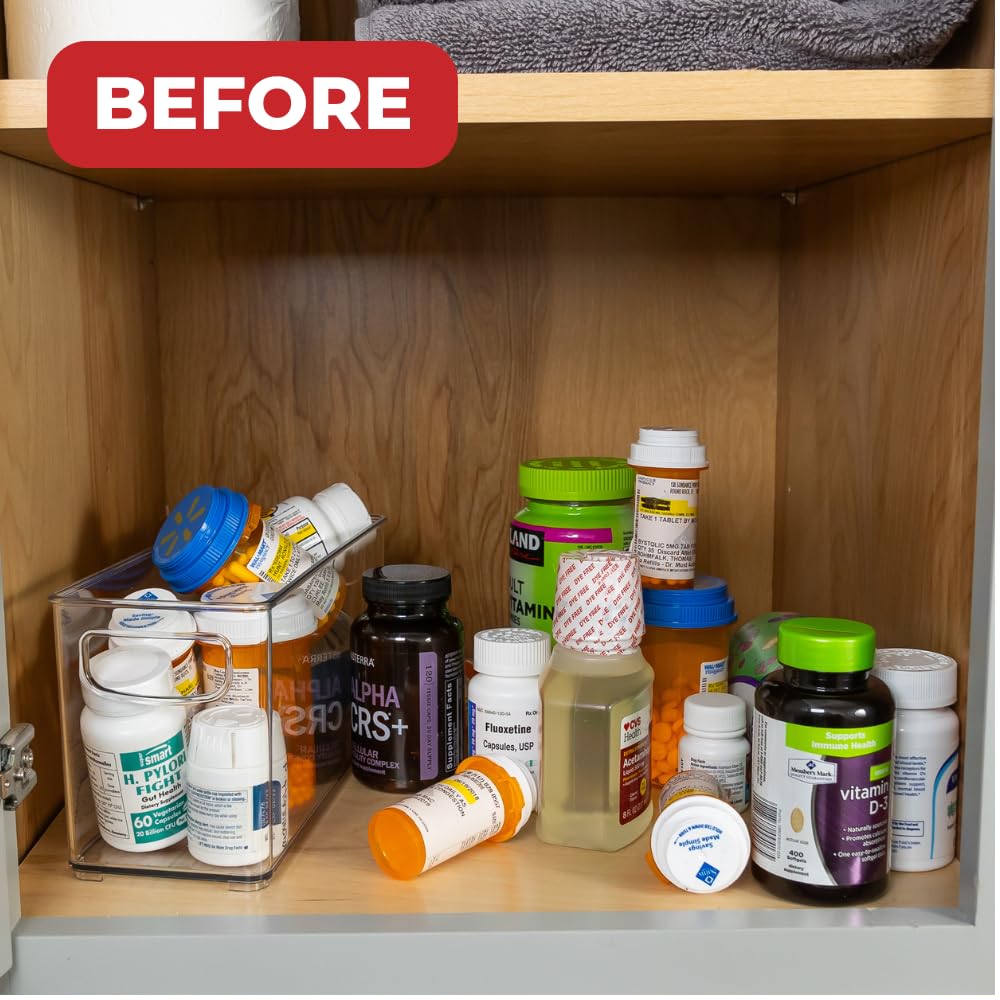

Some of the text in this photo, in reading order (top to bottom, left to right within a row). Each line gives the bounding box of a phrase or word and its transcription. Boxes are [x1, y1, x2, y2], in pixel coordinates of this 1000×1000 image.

[446, 682, 454, 710] Facts
[485, 722, 532, 734] Fluoxetine
[629, 716, 641, 729] CVS
[446, 712, 455, 769] Supplement
[624, 728, 641, 742] Health
[825, 731, 866, 740] Supports
[483, 739, 534, 752] Capsules, USP
[811, 740, 876, 750] Immune Health
[145, 745, 172, 766] smart
[367, 758, 400, 769] COMPLEX
[791, 766, 815, 776] Member's
[124, 773, 139, 785] H.
[136, 771, 181, 796] FIGHT
[142, 782, 182, 803] Gut Health
[840, 780, 889, 801] vitamin
[869, 796, 888, 815] D-3
[134, 815, 153, 829] 60
[678, 834, 720, 847] Made Simple
[846, 833, 872, 842] Promotes
[688, 842, 713, 852] Savings
